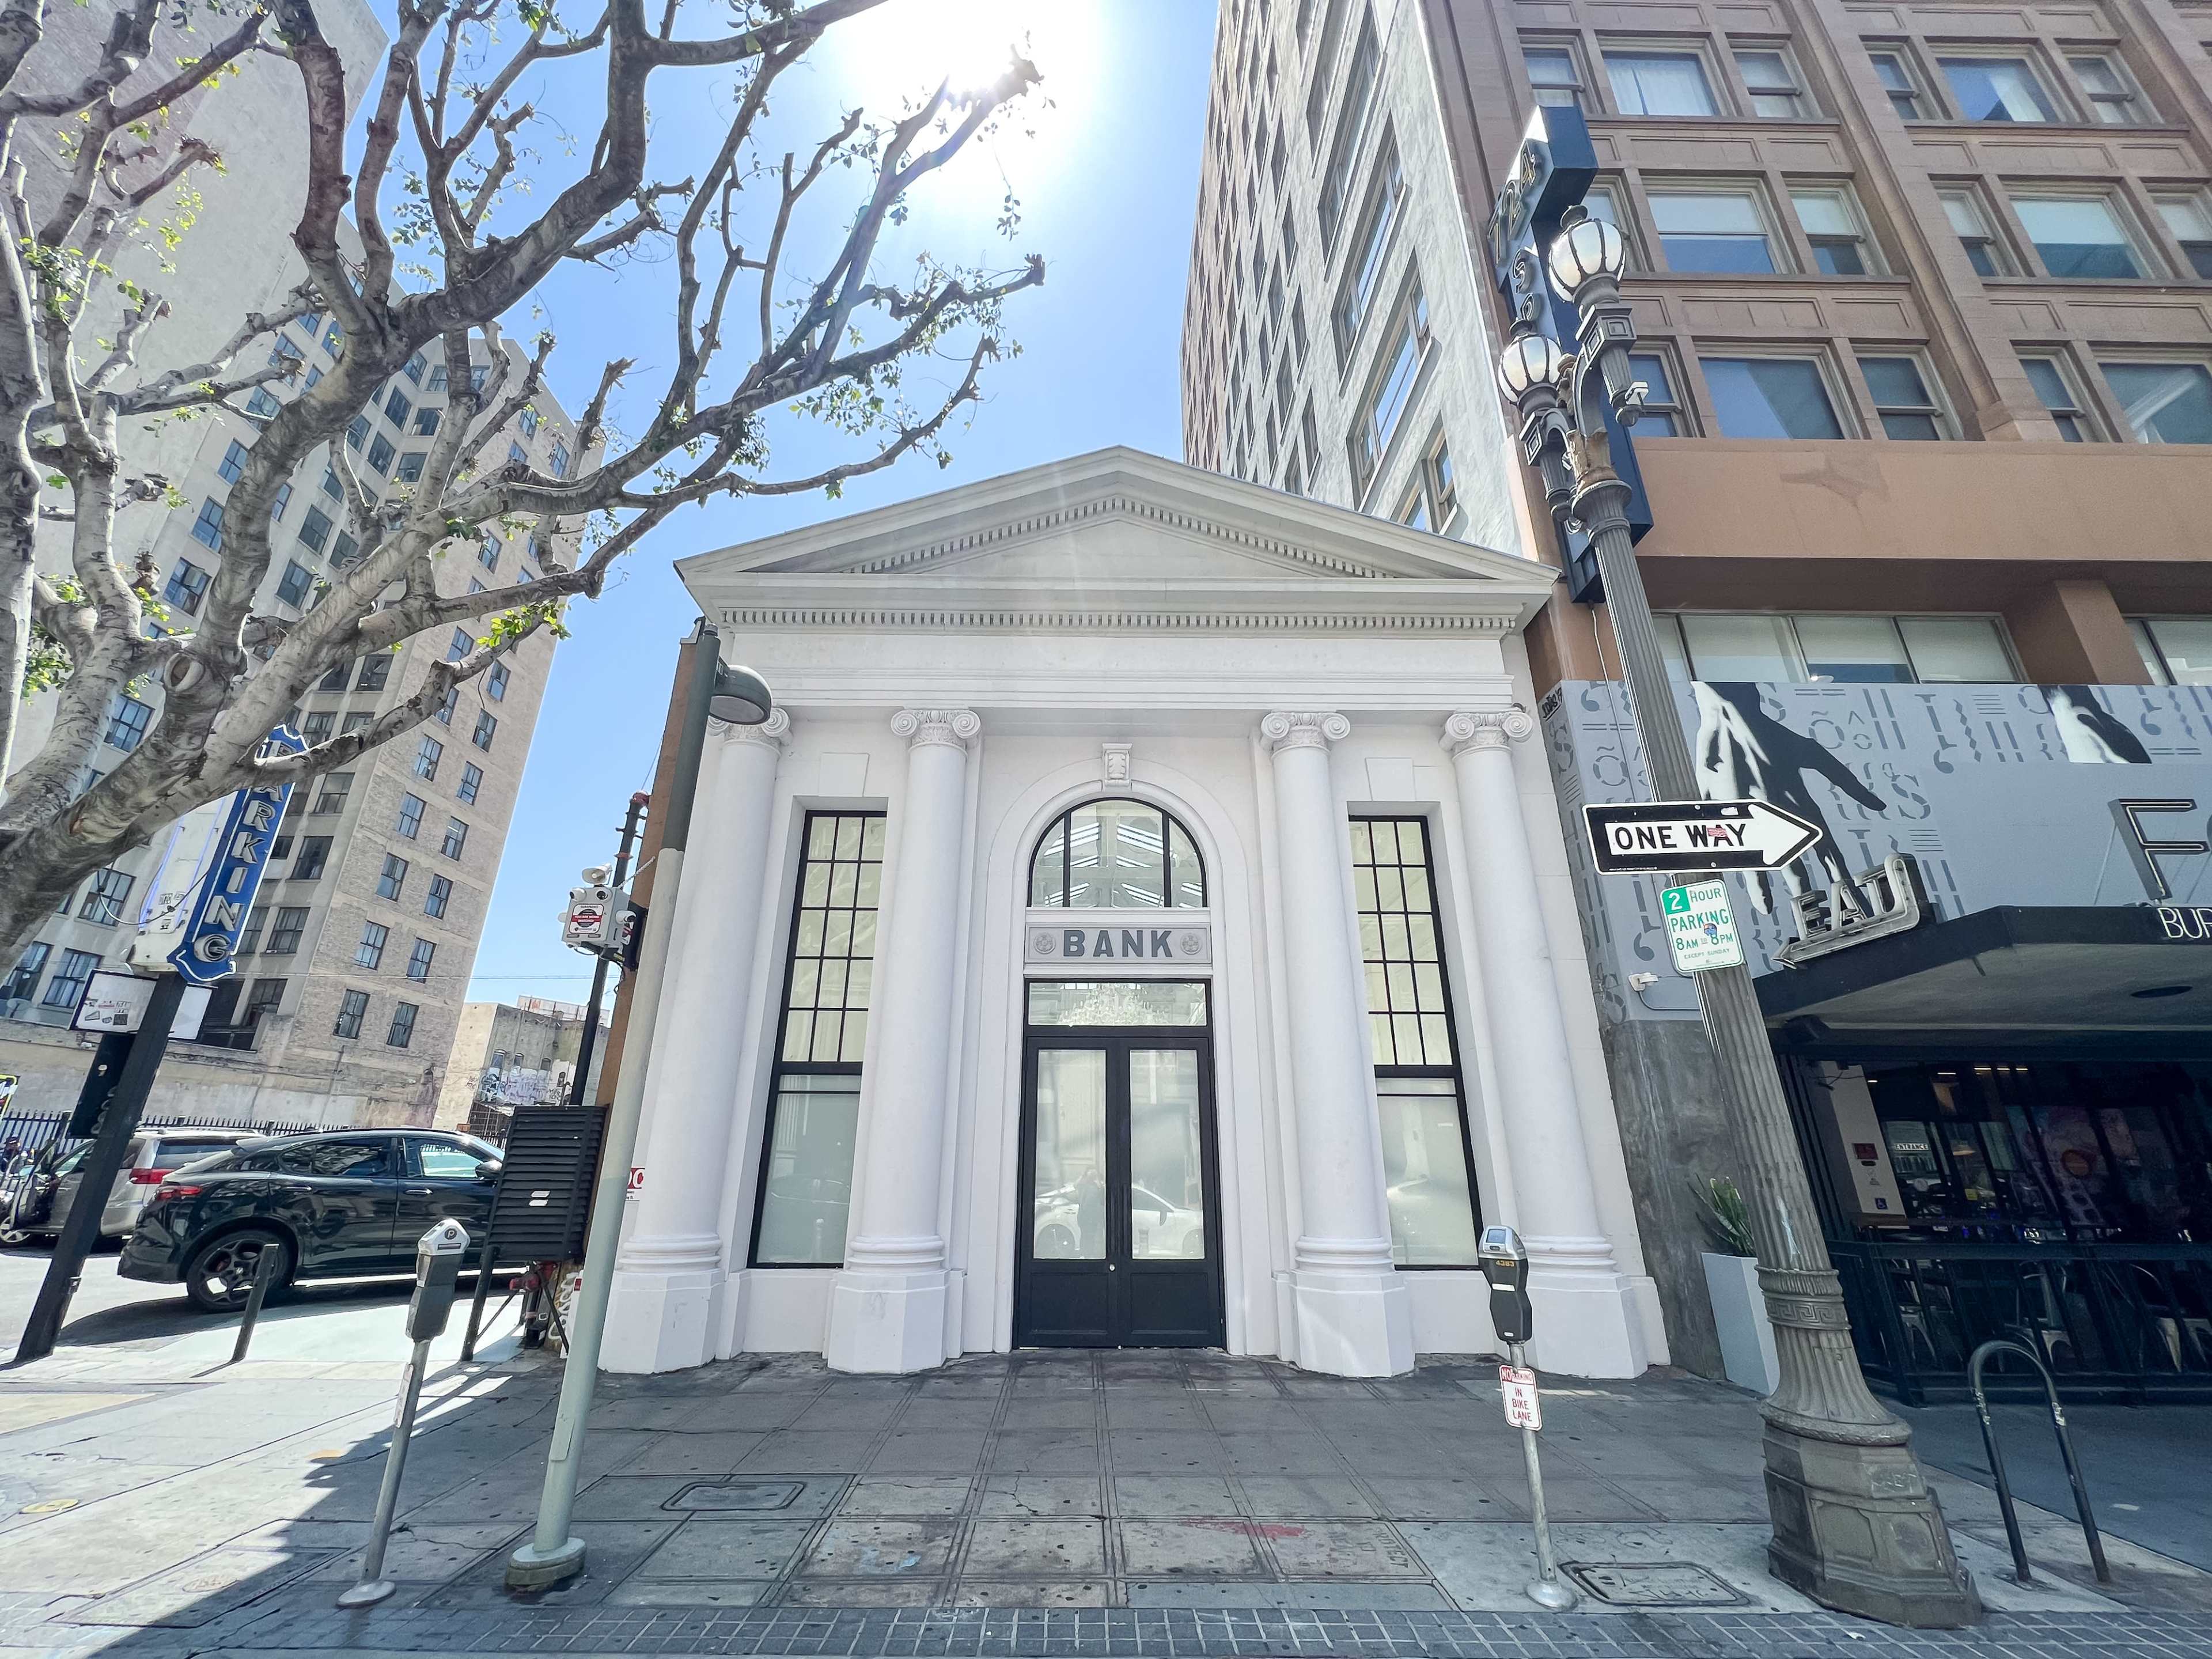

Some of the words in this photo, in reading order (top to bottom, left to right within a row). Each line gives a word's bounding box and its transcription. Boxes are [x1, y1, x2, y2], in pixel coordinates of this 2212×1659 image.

[1615, 825, 1677, 850] ONE
[1685, 824, 1746, 847] WAY
[2107, 798, 2212, 900] F
[1668, 892, 1683, 910] 2
[1690, 888, 1722, 903] HOUR
[1671, 909, 1729, 932] PARKING
[1063, 930, 1173, 957] BANK
[1676, 938, 1699, 950] 8AM
[1710, 933, 1733, 945] 8PM
[1502, 1369, 1512, 1381] NO
[1512, 1373, 1532, 1381] PARKING
[1515, 1387, 1522, 1397] IN
[1512, 1398, 1529, 1410] BIKE
[1513, 1410, 1532, 1422] LANE
